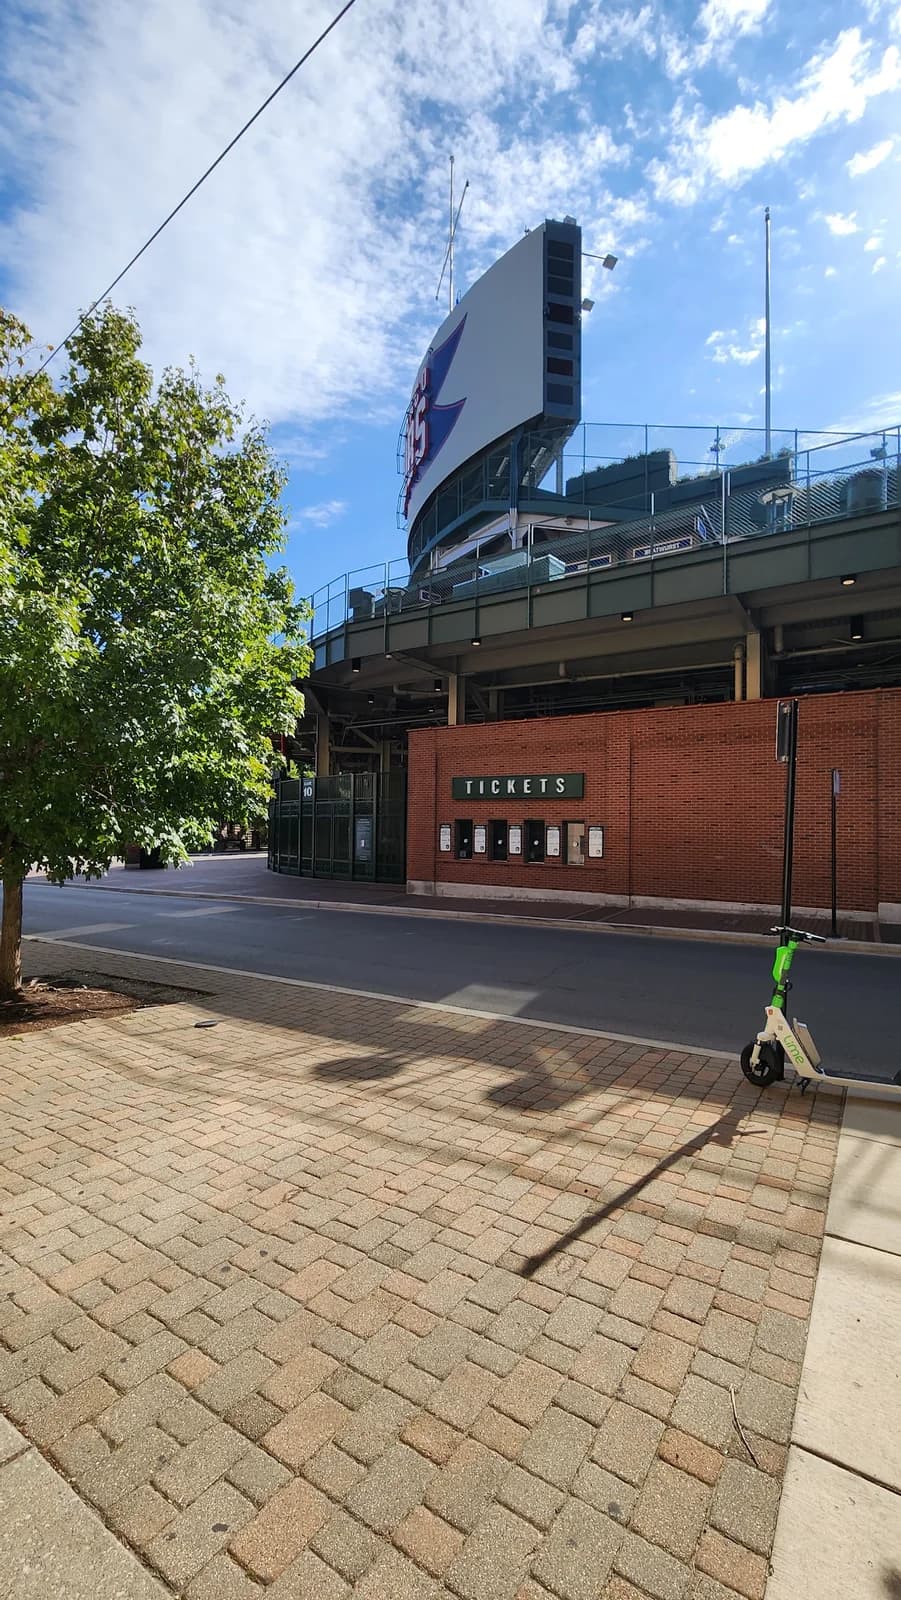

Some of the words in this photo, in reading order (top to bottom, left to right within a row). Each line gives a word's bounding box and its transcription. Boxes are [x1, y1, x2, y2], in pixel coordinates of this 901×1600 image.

[303, 786, 313, 797] 10
[465, 777, 566, 795] TICKETS
[784, 1035, 804, 1064] Lime
